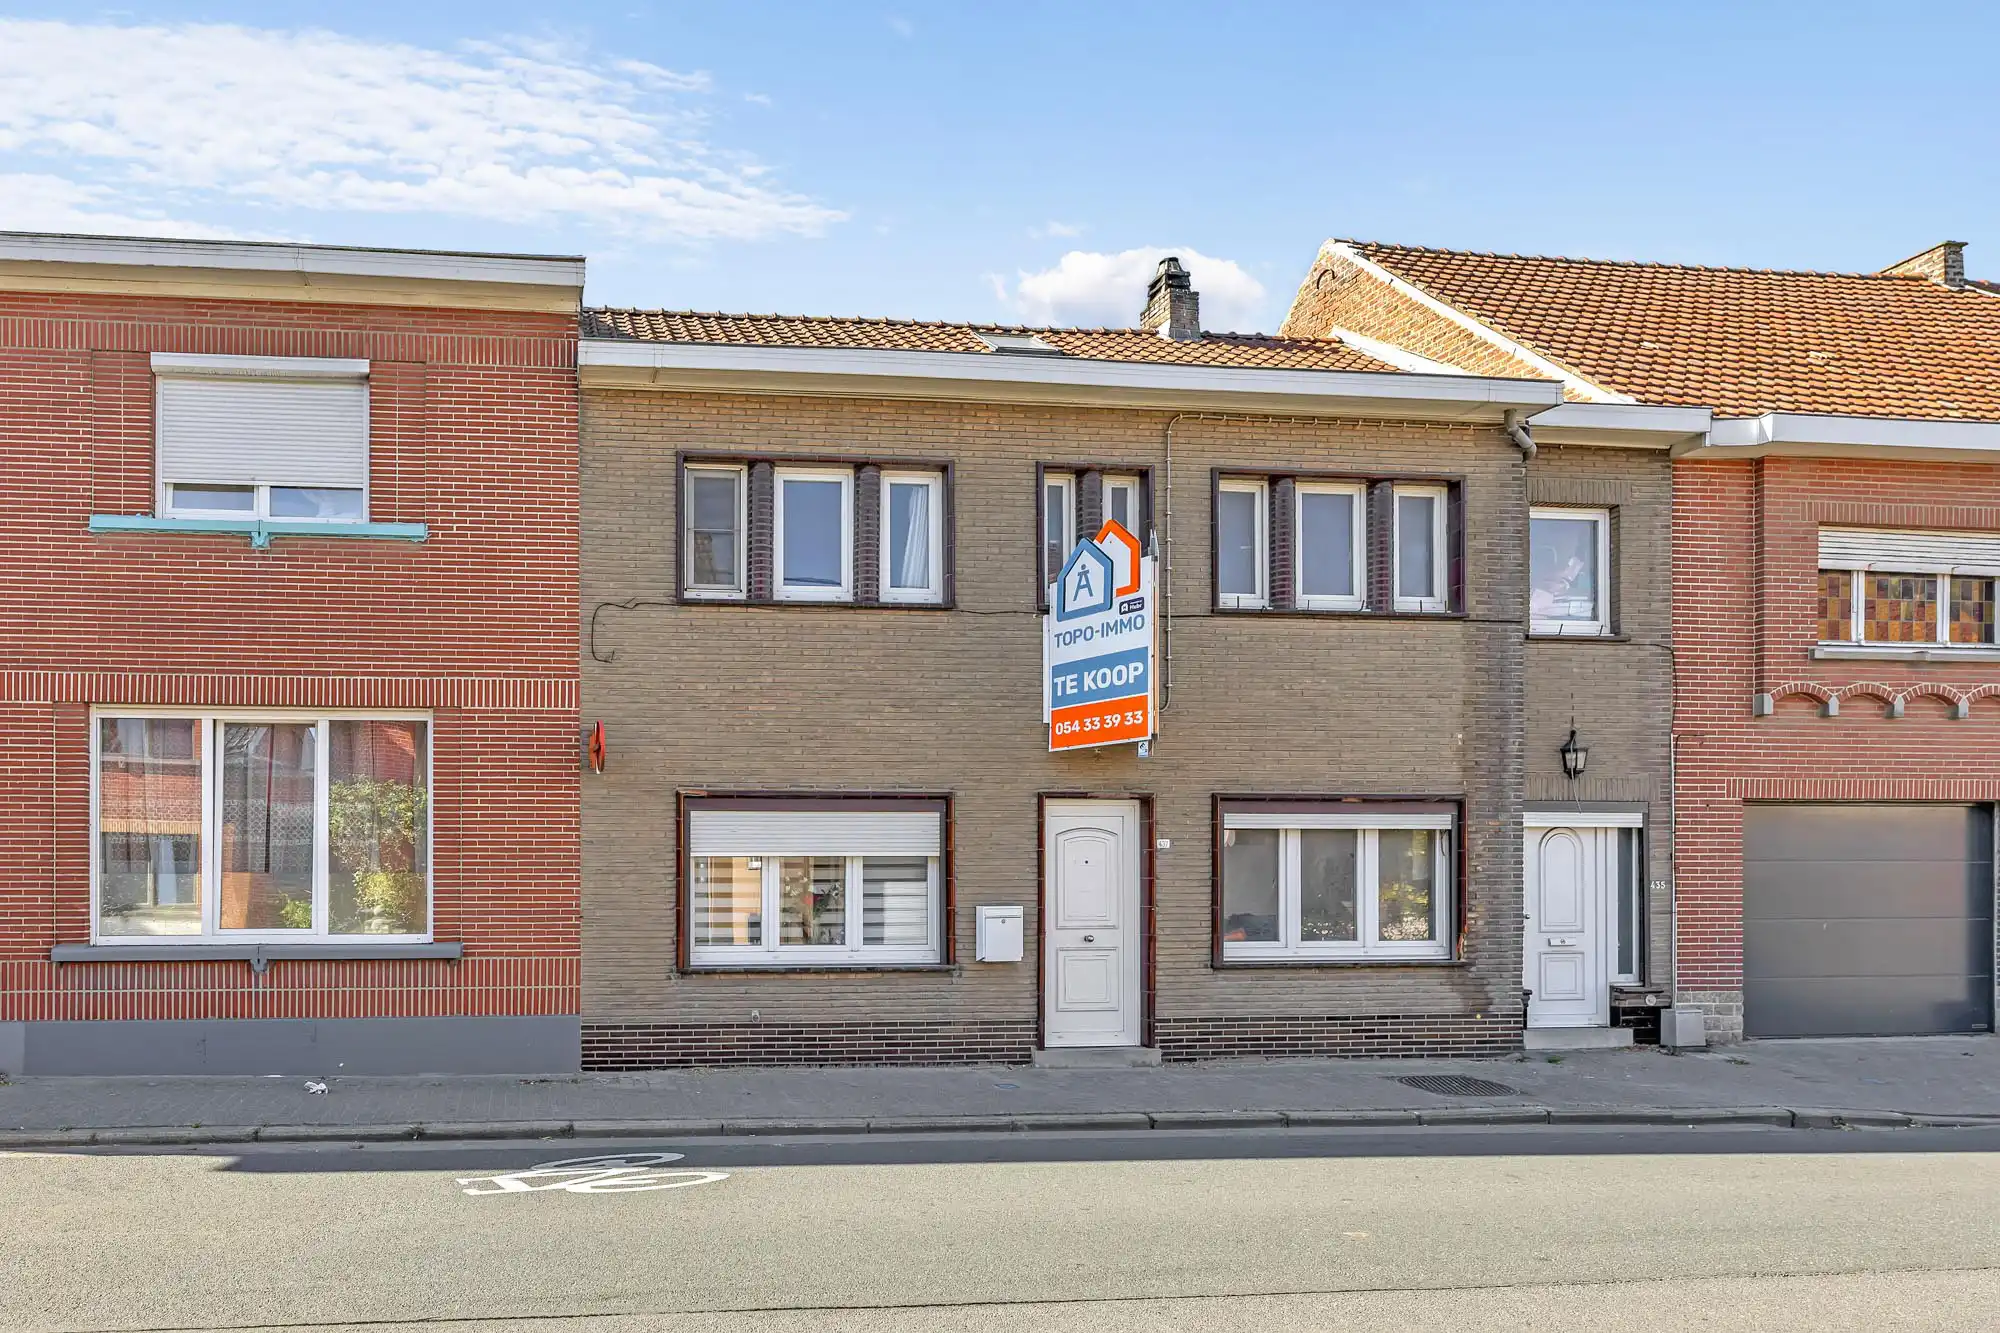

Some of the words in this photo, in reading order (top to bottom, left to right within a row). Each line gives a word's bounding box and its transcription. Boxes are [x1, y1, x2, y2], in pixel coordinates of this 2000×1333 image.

[1054, 614, 1145, 648] TOPO-IMMO
[1053, 673, 1078, 696] TE
[1083, 662, 1144, 691] KOOP
[1055, 720, 1080, 735] 054
[1083, 716, 1101, 731] 33
[1103, 714, 1121, 728] 39
[1124, 710, 1144, 725] 33
[1650, 880, 1666, 889] 435
